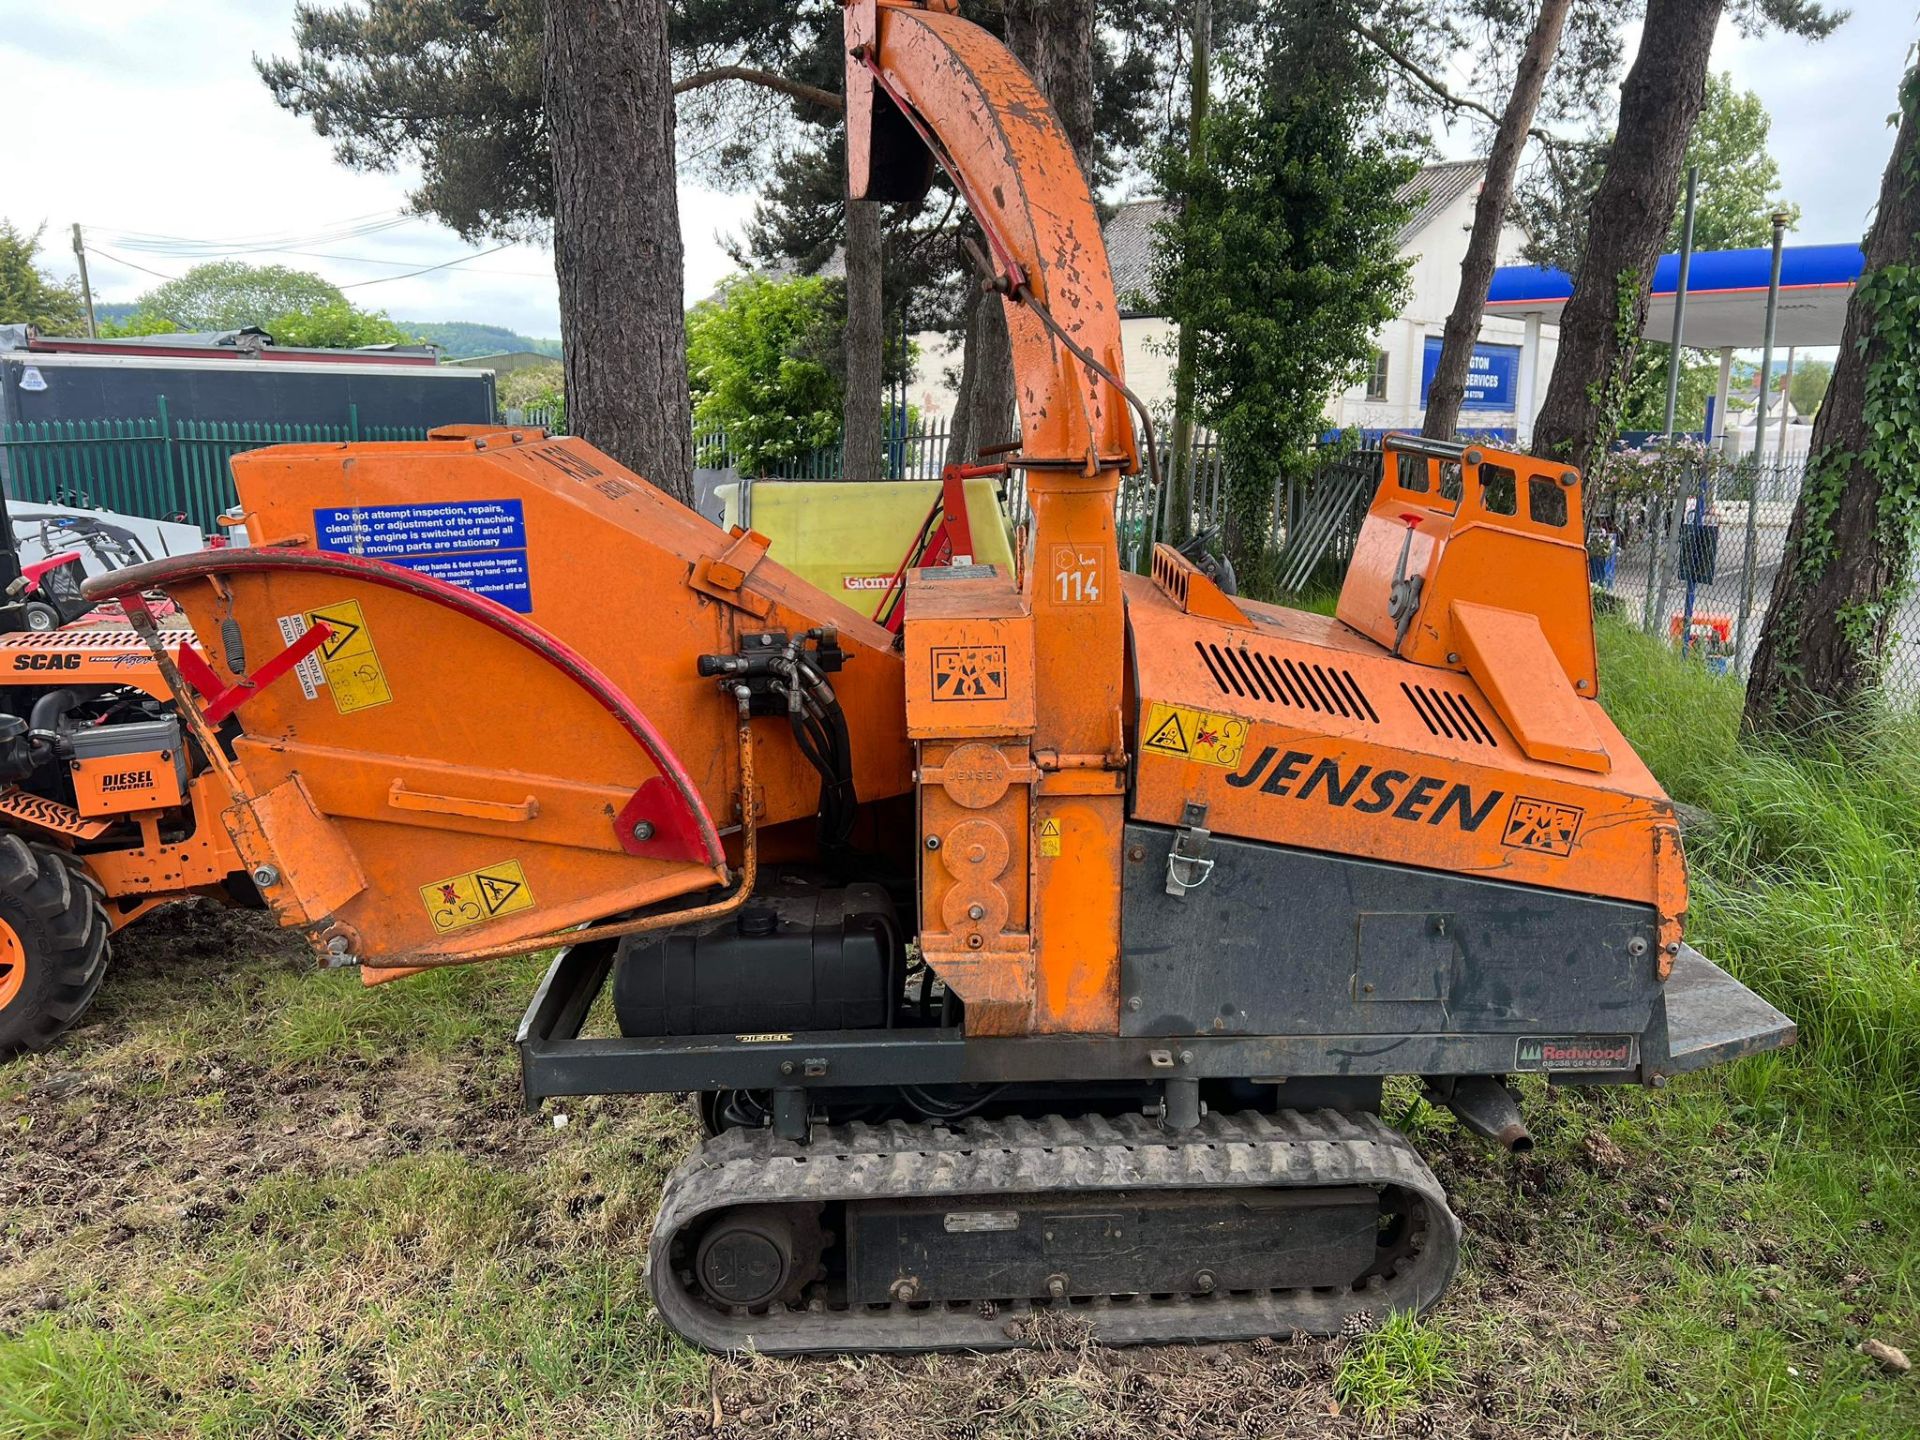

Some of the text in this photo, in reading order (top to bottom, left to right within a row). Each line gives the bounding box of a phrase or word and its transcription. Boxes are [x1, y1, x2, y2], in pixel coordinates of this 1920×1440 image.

[1470, 356, 1490, 370] GTON
[1466, 374, 1498, 388] SERVICES
[334, 504, 504, 521] Do not attempt inspection, repairs,
[374, 522, 386, 530] or
[388, 518, 444, 530] adjustment
[445, 518, 456, 526] of
[458, 516, 474, 525] the
[475, 515, 515, 524] machine
[330, 526, 513, 544] until the engine is switched off and all
[348, 538, 500, 555] the moving parts are stationary
[431, 562, 451, 570] hands
[472, 559, 495, 568] outside
[496, 558, 518, 566] hopper
[476, 584, 504, 592] switched
[1056, 572, 1099, 600] 114
[13, 654, 82, 670] SCAG
[280, 619, 314, 697] PUSH ELEASE
[307, 654, 322, 682] ANDLE
[102, 770, 152, 786] DIESEL
[949, 770, 1003, 780] JENSEN
[102, 782, 154, 792] POWERED
[1225, 746, 1505, 832] JENSEN
[1542, 1045, 1628, 1060] Redwood
